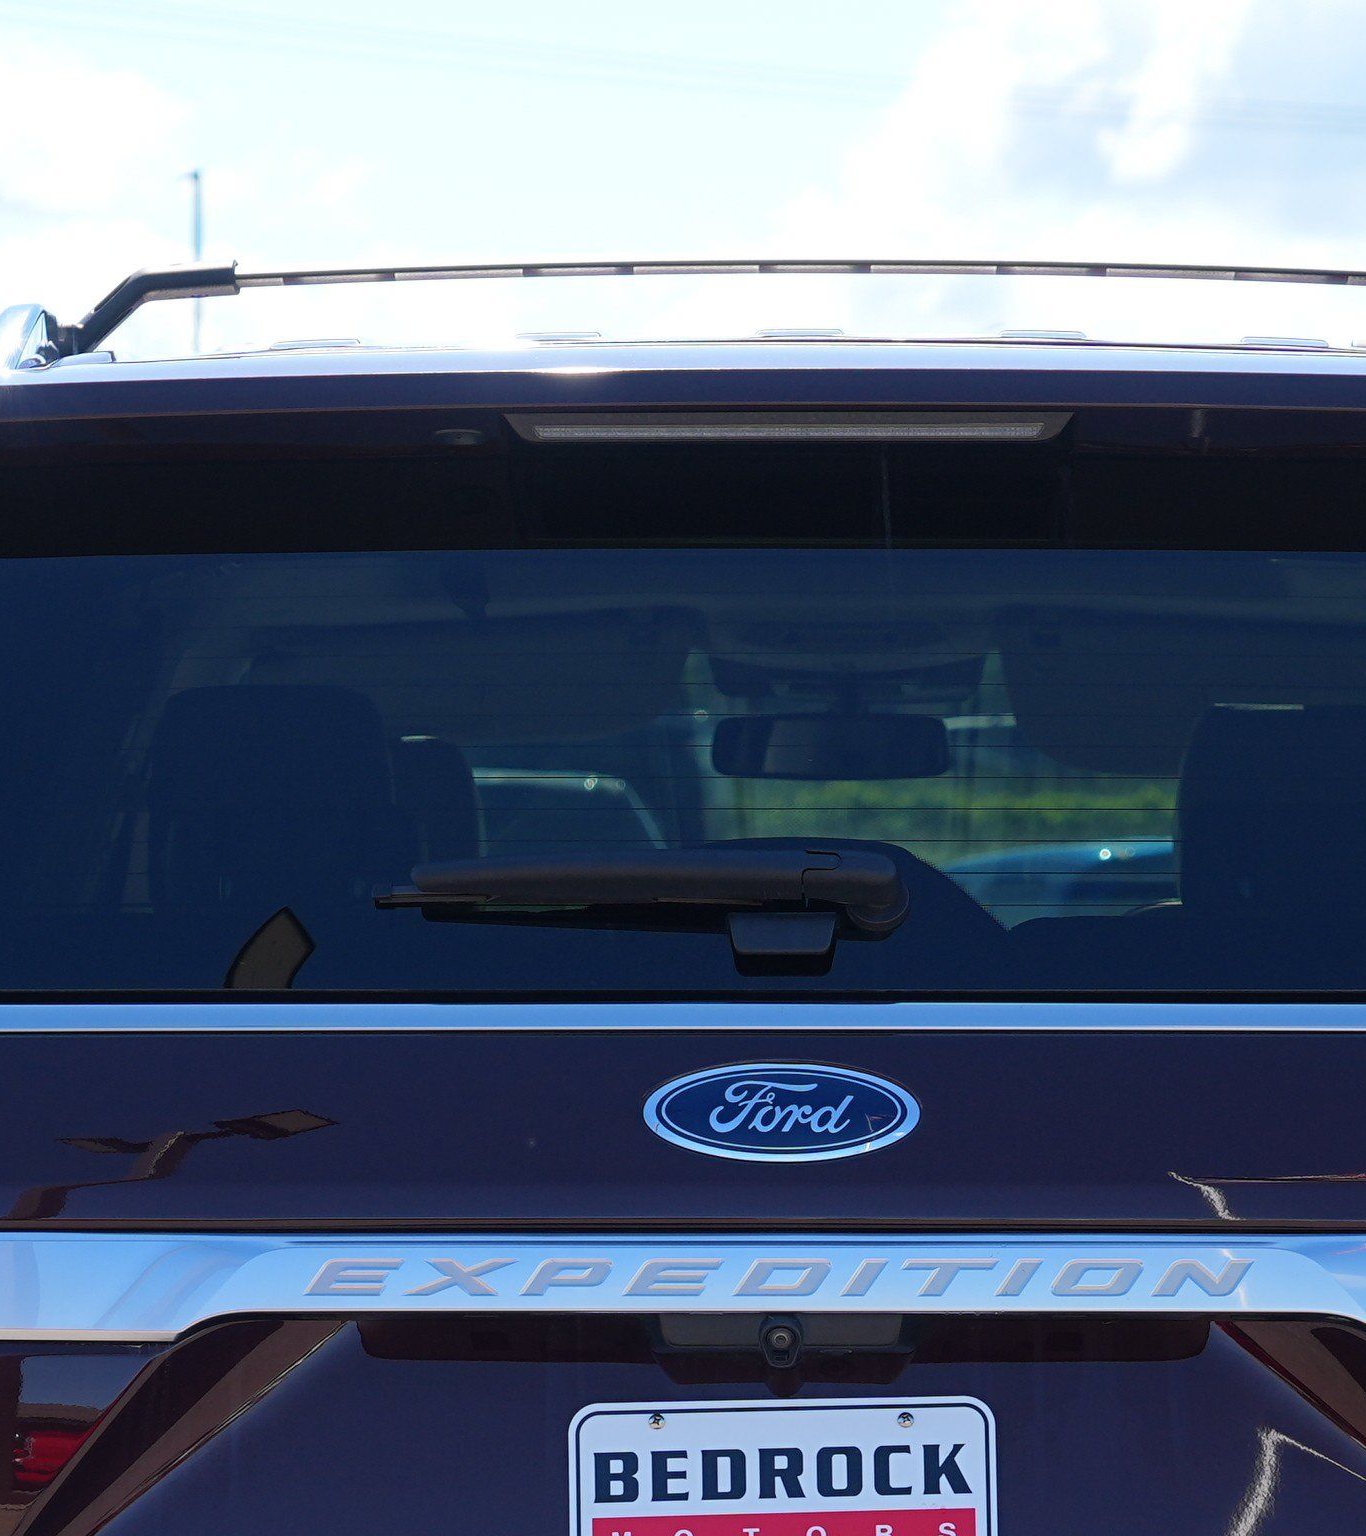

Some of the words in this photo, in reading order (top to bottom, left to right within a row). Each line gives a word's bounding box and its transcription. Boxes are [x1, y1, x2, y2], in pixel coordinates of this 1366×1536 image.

[708, 1079, 852, 1135] Ford
[302, 1256, 1256, 1297] EXPEDITION
[593, 1443, 973, 1504] BEDROCK
